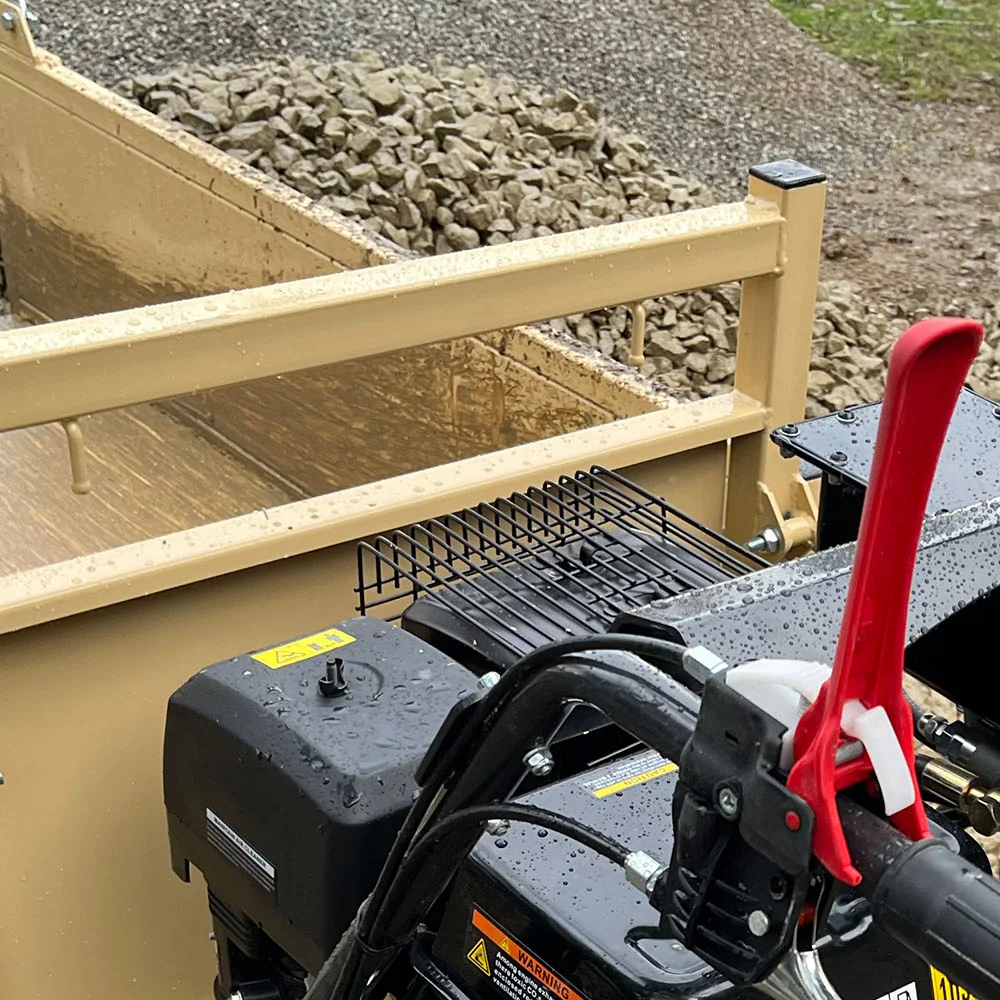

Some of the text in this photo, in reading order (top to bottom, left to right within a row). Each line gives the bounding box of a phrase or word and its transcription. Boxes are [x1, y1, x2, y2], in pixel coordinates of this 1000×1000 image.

[494, 968, 523, 996] enclosed
[495, 959, 511, 977] there
[511, 972, 527, 990] toxic
[496, 951, 518, 974] Among
[517, 969, 538, 990] engine
[518, 949, 570, 1000] WARNING
